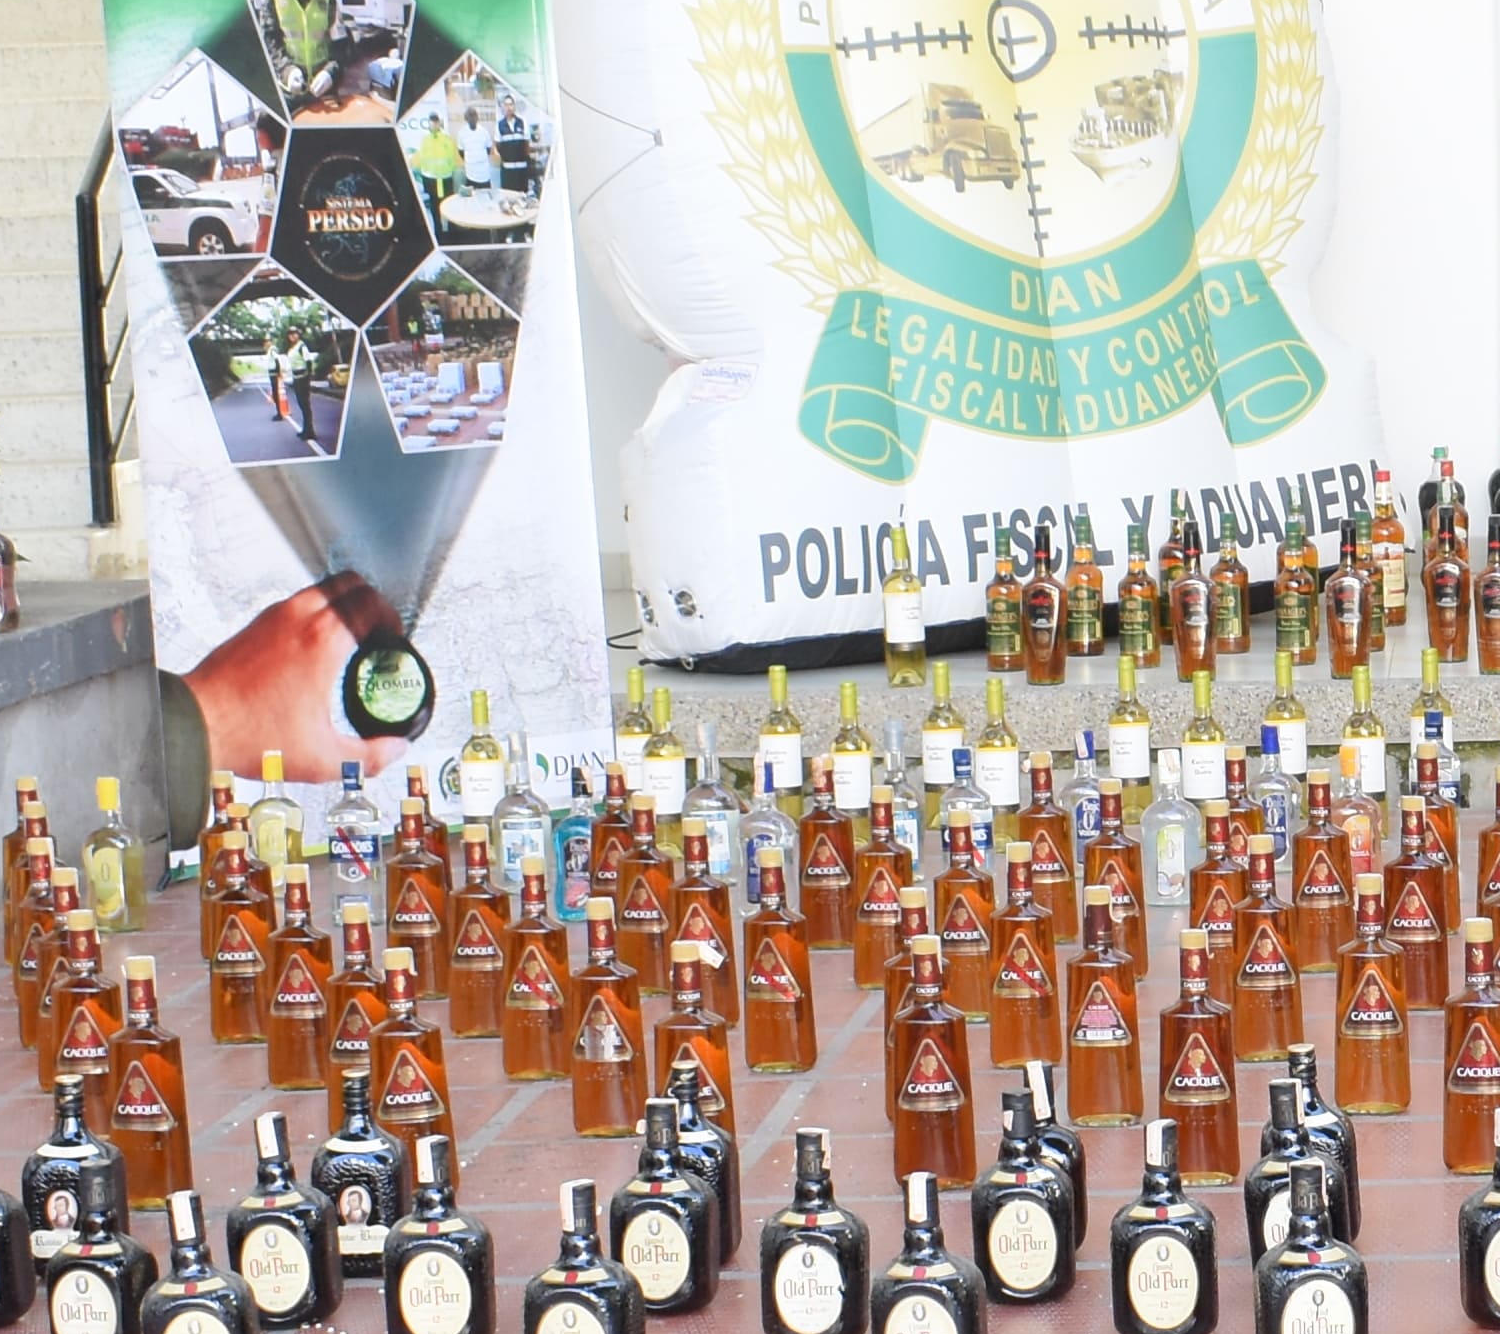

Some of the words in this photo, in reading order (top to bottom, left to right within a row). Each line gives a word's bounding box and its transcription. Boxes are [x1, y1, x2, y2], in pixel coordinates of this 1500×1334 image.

[306, 207, 395, 233] PERSEO
[1009, 262, 1122, 317] DIAN
[850, 298, 1059, 389] LEGALIDAD
[1067, 345, 1096, 386] Y
[1107, 269, 1260, 376] CONTROL
[887, 356, 1027, 432] FISCAL
[1035, 394, 1051, 434] Y
[1056, 336, 1219, 434] ADUANERO
[1305, 885, 1346, 895] CACIQUE
[396, 912, 432, 923] CACIQUE
[1394, 918, 1432, 929] CACIQUE
[218, 951, 256, 962] CACIQUE
[1246, 963, 1286, 974] CACIQUE
[1350, 1010, 1394, 1022] CACIQUE
[63, 1047, 108, 1059] CACIQUE
[1175, 1076, 1220, 1087] CACIQUE
[907, 1082, 955, 1094] CACIQUE
[385, 1093, 431, 1106] CACIQUE
[117, 1104, 162, 1116] CACIQUE
